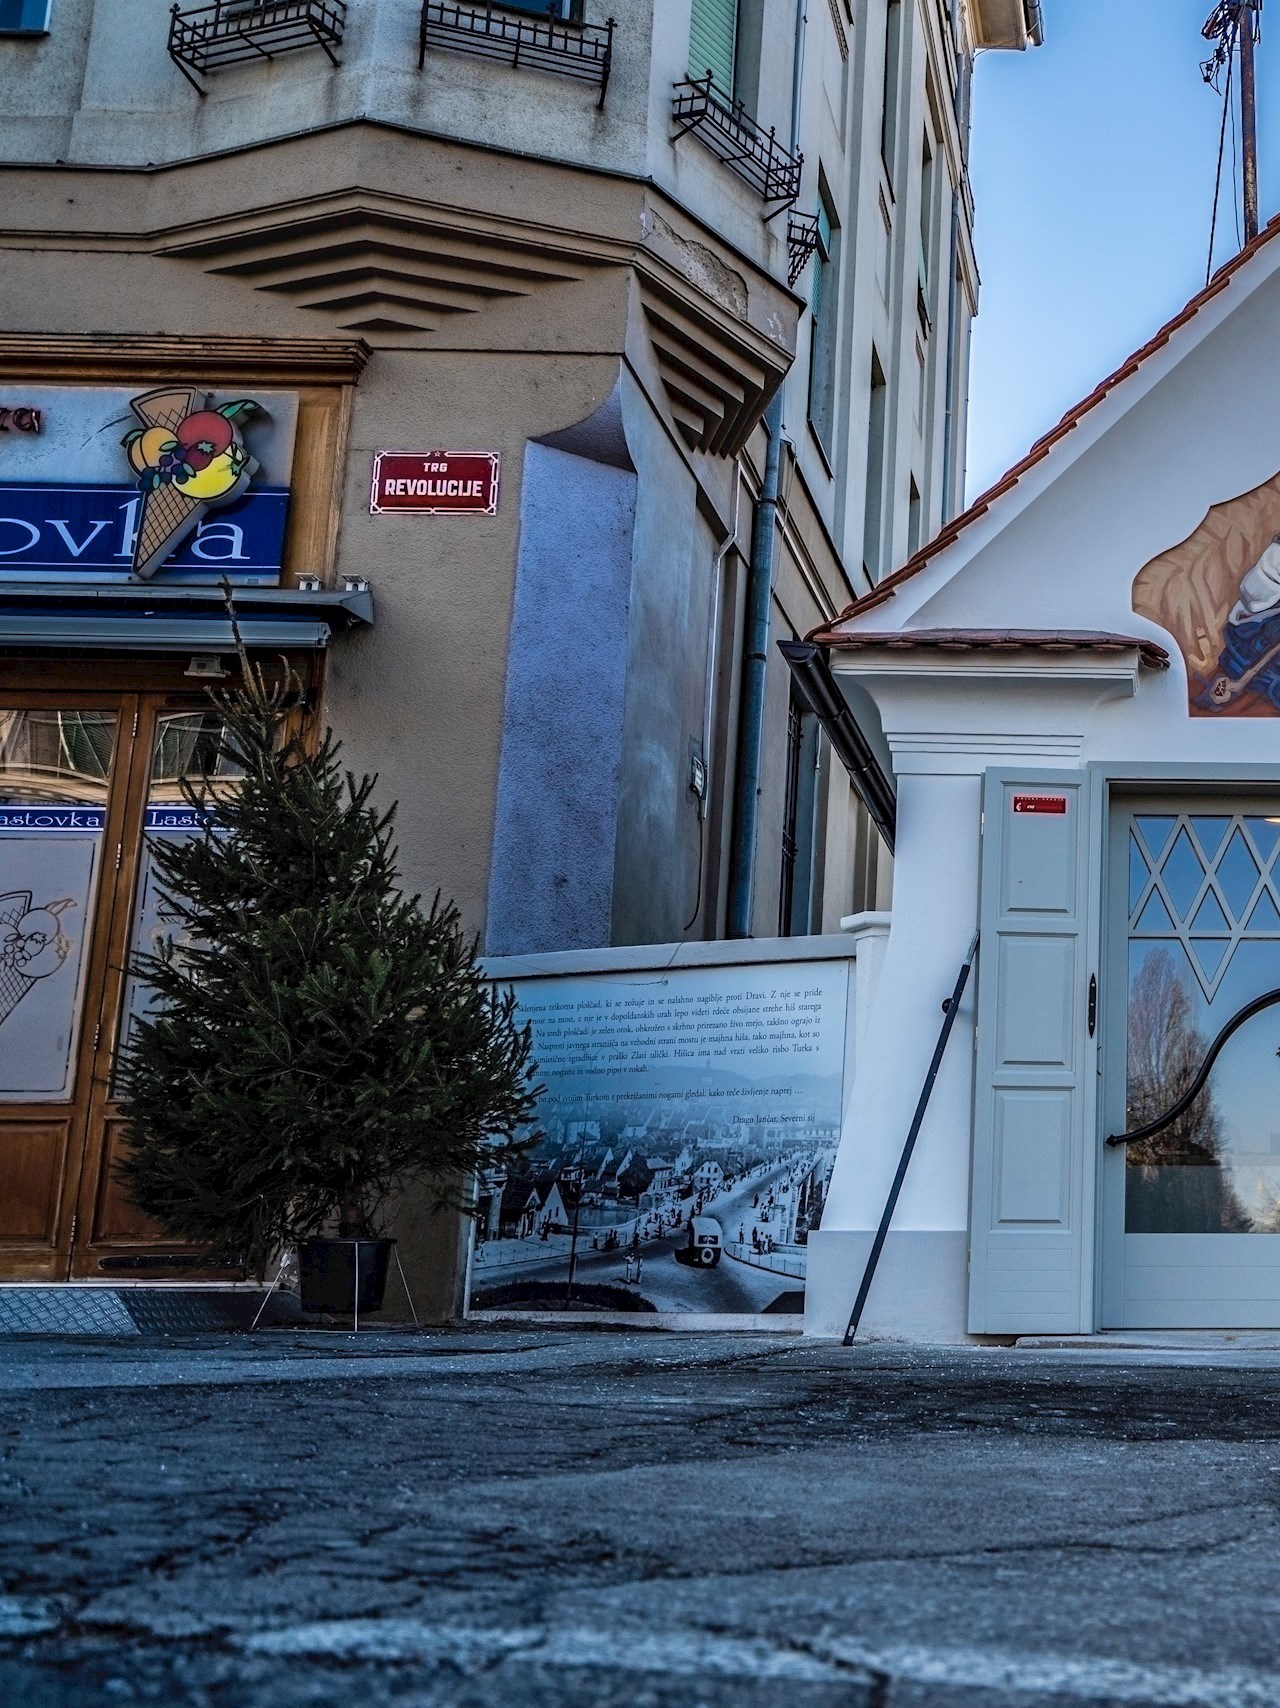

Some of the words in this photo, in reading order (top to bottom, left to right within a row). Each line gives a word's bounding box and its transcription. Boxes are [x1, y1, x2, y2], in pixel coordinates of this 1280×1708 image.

[423, 462, 448, 473] TRG
[384, 478, 483, 497] REVOLUCIJE
[605, 999, 612, 1008] ki
[647, 997, 655, 1005] in
[667, 995, 694, 1004] nalahno
[696, 993, 723, 1005] nagiblje
[726, 991, 743, 1004] proti
[780, 989, 791, 1000] nje
[804, 987, 823, 999] pride
[584, 1013, 594, 1025] nje
[596, 1013, 602, 1024] je
[610, 1010, 654, 1023] dopoldanskih
[656, 1009, 672, 1018] urah
[674, 1009, 689, 1020] lepo
[691, 1007, 710, 1017] videti
[732, 1005, 760, 1017] obsijane
[762, 1004, 782, 1013] strehe
[798, 1004, 822, 1013] starega
[536, 1029, 545, 1037] Na
[546, 1028, 562, 1037] sredi
[590, 1026, 597, 1038] je
[598, 1025, 615, 1034] zelen
[672, 1021, 695, 1031] skrbno
[696, 1020, 728, 1032] prirezano
[790, 1015, 813, 1027] ograjo
[814, 1015, 821, 1023] iz
[538, 1040, 564, 1052] Nasproti
[566, 1040, 590, 1051] javnega
[630, 1036, 656, 1046] vzhodni
[658, 1035, 676, 1044] strani
[700, 1034, 706, 1045] je
[708, 1033, 733, 1045] majhna
[752, 1031, 767, 1040] tako
[798, 1029, 811, 1038] kot
[630, 1050, 647, 1059] Zlati
[698, 1048, 711, 1057] ima
[713, 1047, 726, 1056] nad
[729, 1046, 745, 1055] vrati
[748, 1046, 769, 1055] veliko
[772, 1045, 790, 1054] risbo
[792, 1044, 813, 1053] Turka
[552, 1066, 576, 1078] nogami
[577, 1066, 584, 1075] in
[585, 1066, 606, 1074] vodno
[606, 1065, 622, 1076] pipo
[548, 1093, 561, 1105] pod
[584, 1092, 610, 1101] Turkom
[658, 1089, 684, 1101] nogami
[708, 1088, 724, 1097] kako
[770, 1085, 792, 1097] naprej
[732, 1115, 754, 1126] Drago
[780, 1113, 806, 1122] Severni
[807, 1112, 816, 1124] sij
